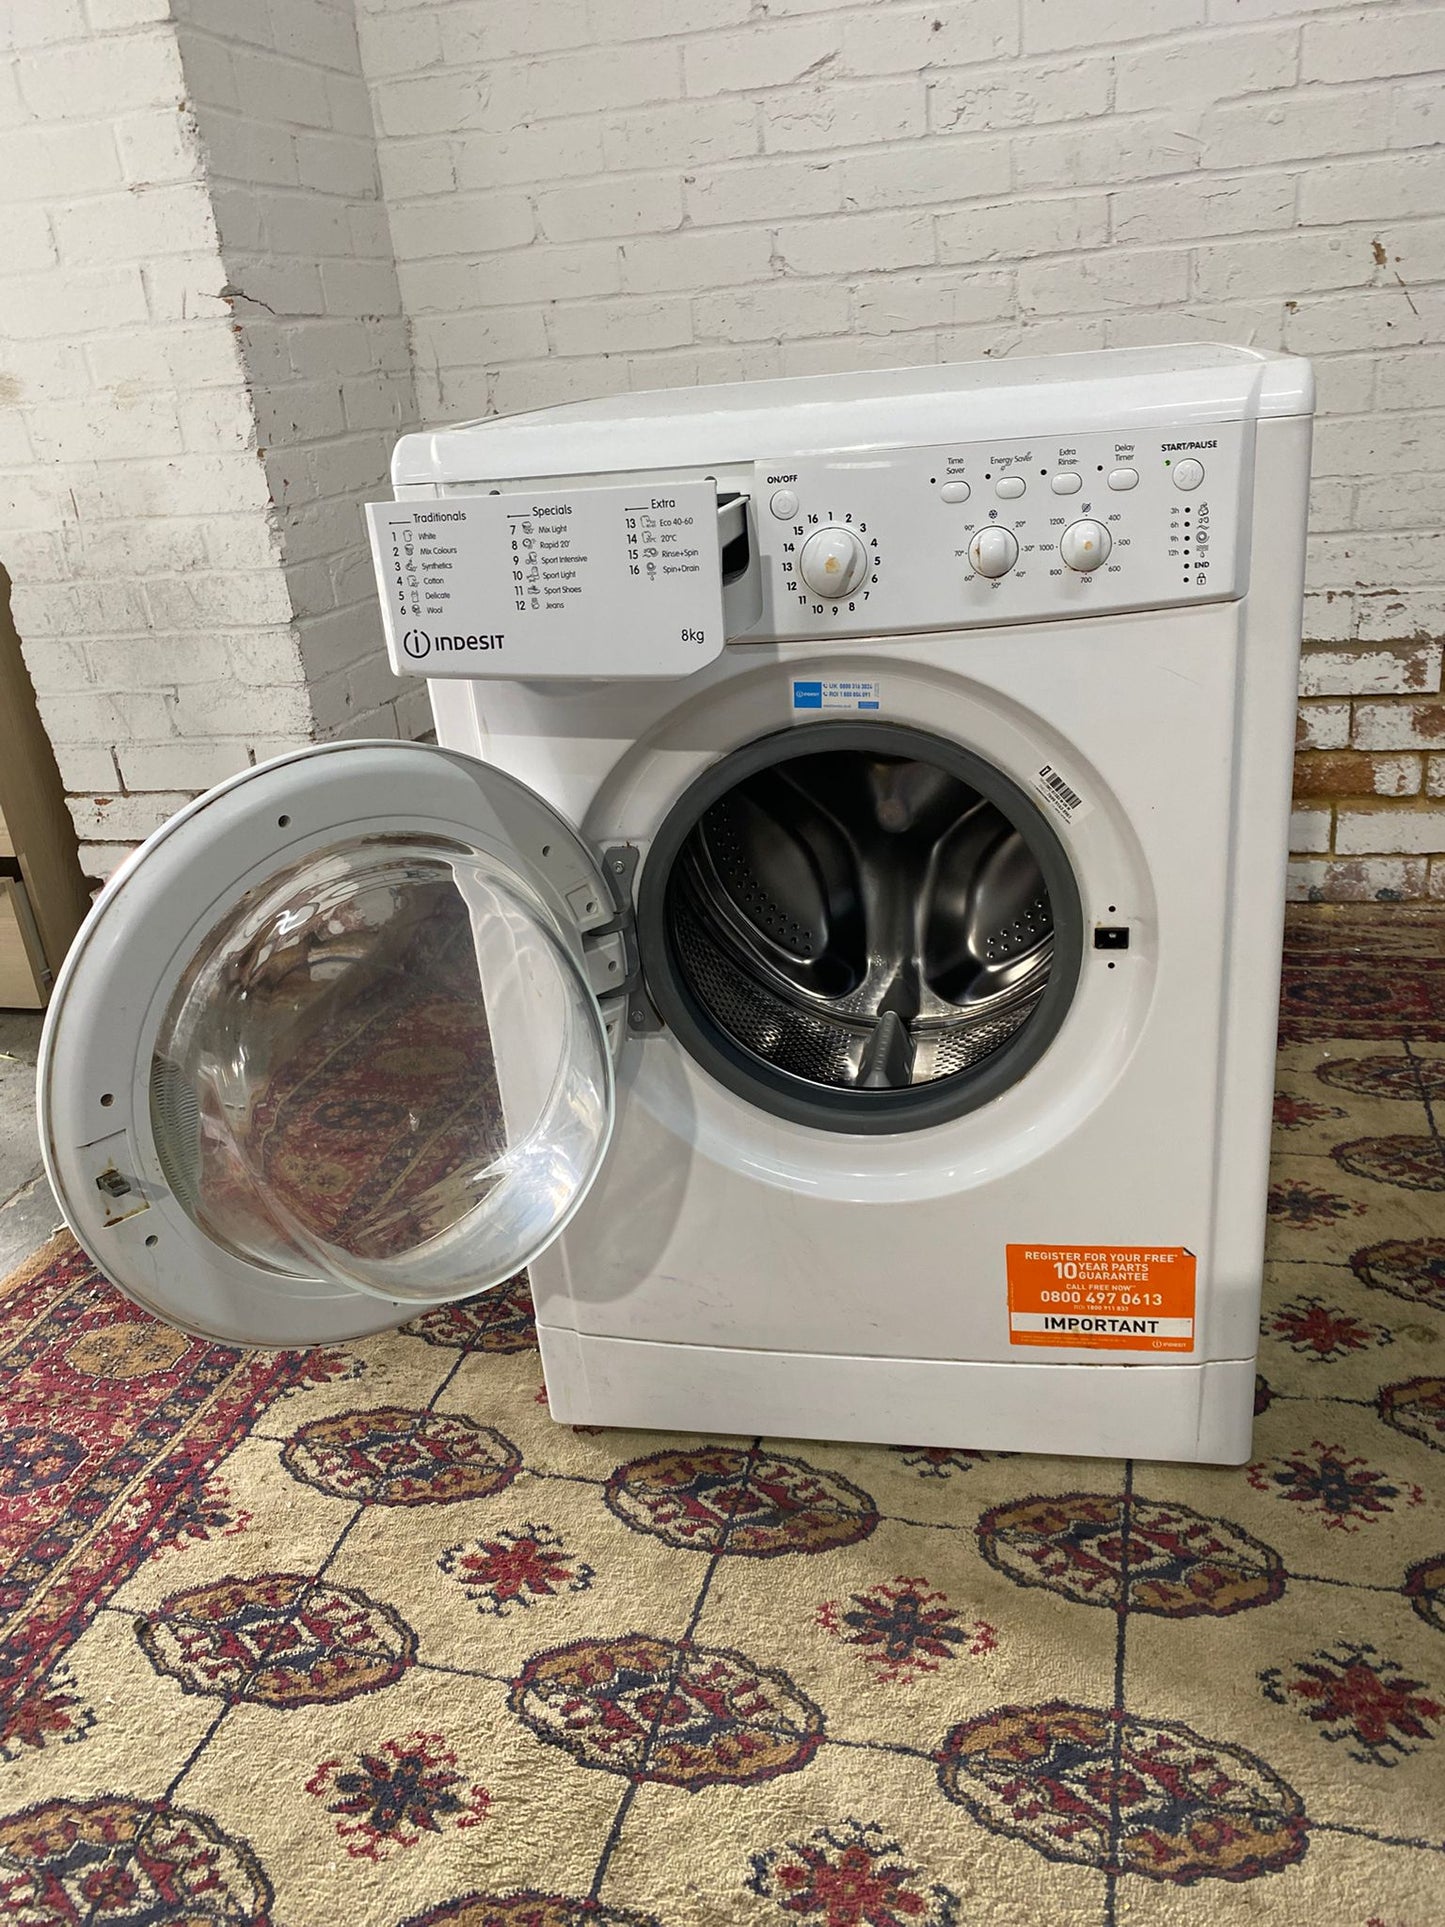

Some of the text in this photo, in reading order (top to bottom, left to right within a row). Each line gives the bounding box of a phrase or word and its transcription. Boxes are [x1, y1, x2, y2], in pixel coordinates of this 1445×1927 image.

[1114, 444, 1135, 452] Delay
[1161, 440, 1218, 452] START/PAUSE
[948, 457, 964, 465] Time
[990, 453, 1033, 467] Energy Saver
[767, 475, 798, 484] ON/OFF
[651, 499, 676, 509] Extra
[532, 504, 573, 518] Specials
[828, 511, 833, 521] 1
[413, 511, 467, 523] Traditionals
[807, 514, 819, 524] 16
[845, 513, 852, 523] 2
[625, 517, 694, 529] 13 Eco 40-60
[860, 523, 867, 532] 3
[510, 525, 567, 535] 7 Mix Light
[793, 526, 804, 535] 15
[392, 531, 437, 542] 1 White
[627, 533, 637, 544] 14
[512, 540, 518, 550] 8
[540, 541, 559, 550] Rapid
[783, 543, 795, 552] 14
[870, 538, 878, 547] 4
[392, 546, 399, 557] 2
[433, 547, 457, 555] Colours
[628, 549, 699, 560] 15 Rinse+Spin
[513, 555, 588, 565] 9 Sport Intensive
[874, 556, 881, 565] 5
[395, 562, 453, 571] 3 Synthetics
[629, 564, 700, 575] 16 Spin+Drain
[782, 562, 793, 571] 13
[512, 570, 576, 581] 10 Sport Light
[1049, 568, 1062, 576] 800
[397, 576, 403, 586] 4
[872, 574, 878, 583] 6
[514, 585, 523, 596] 11
[544, 587, 561, 596] Sport
[787, 582, 797, 591] 12
[399, 591, 405, 600] 5
[798, 595, 807, 604] 11
[863, 591, 870, 600] 7
[400, 606, 406, 615] 6
[515, 600, 526, 611] 12
[812, 605, 824, 614] 10
[849, 602, 855, 611] 8
[832, 606, 838, 616] 9
[681, 629, 704, 644] 8kg
[1025, 1251, 1081, 1261] REGISTER
[1084, 1253, 1107, 1261] FOR
[1110, 1253, 1141, 1262] YOUR
[1053, 1261, 1078, 1279] 10
[1079, 1262, 1149, 1272] YEAR PARTS
[1079, 1271, 1149, 1281] GUARANTEE
[1040, 1290, 1162, 1306] 0800 497 0613
[1044, 1317, 1159, 1334] IMPORTANT
